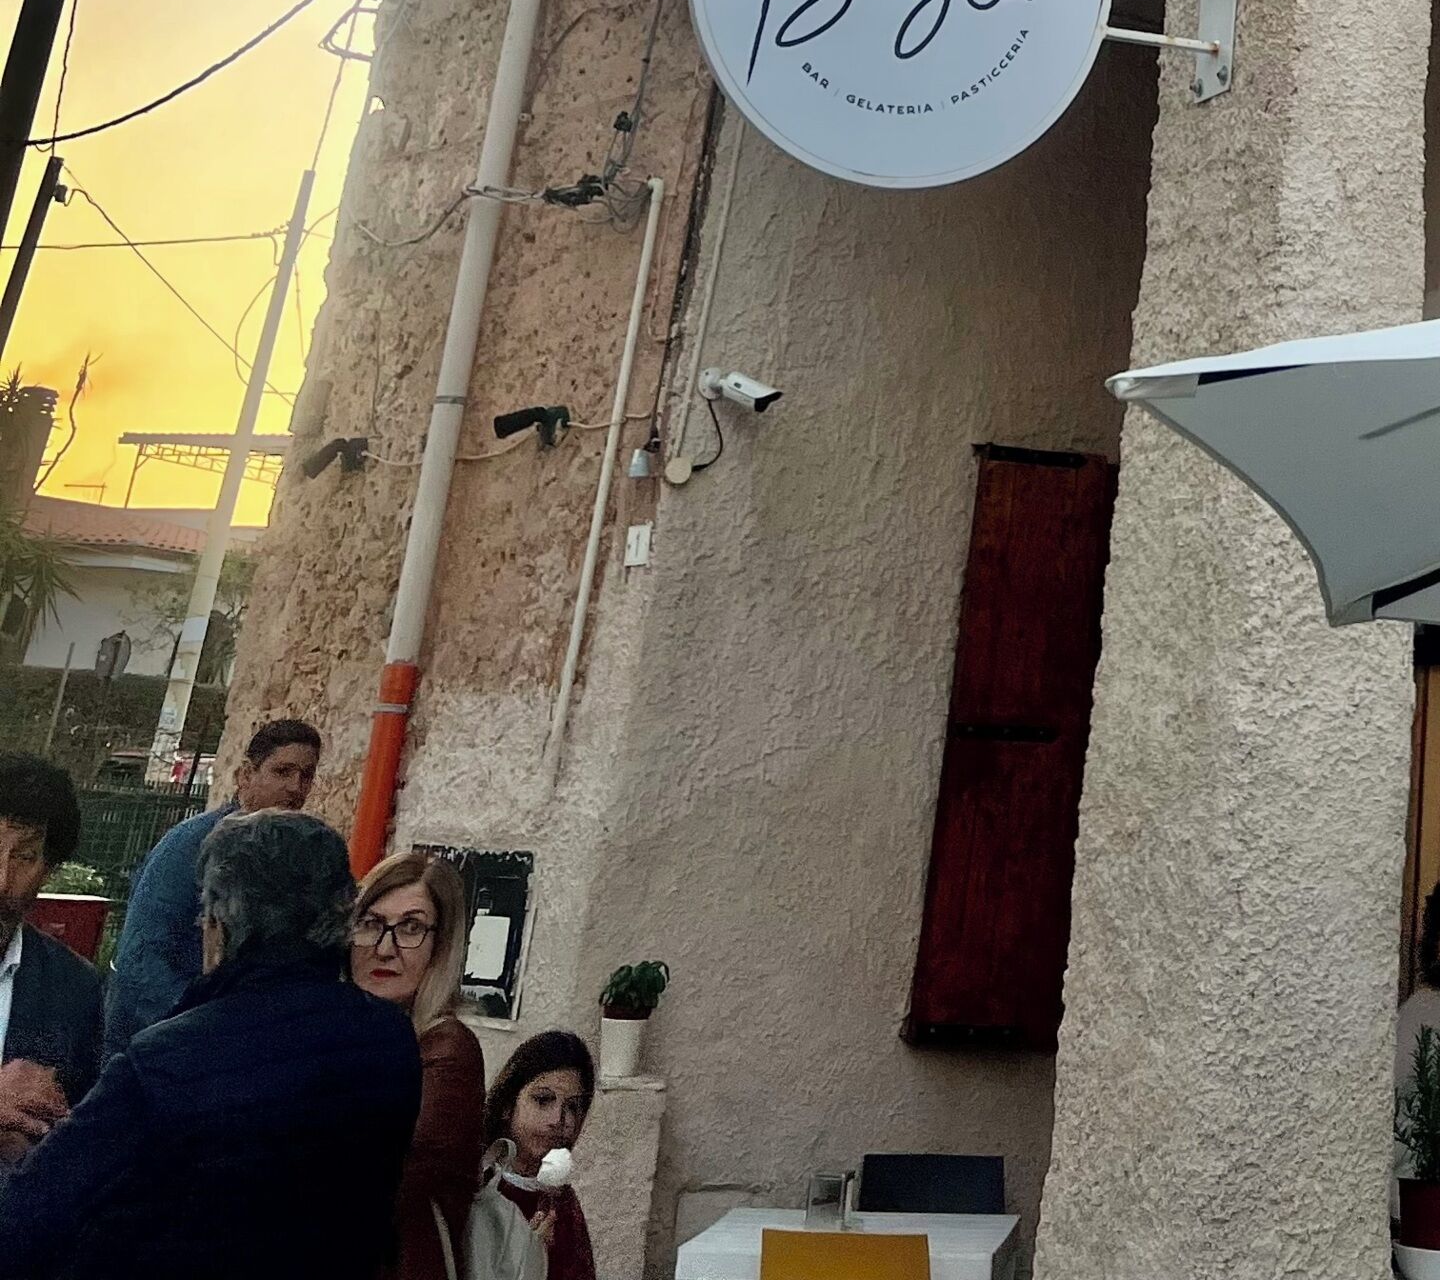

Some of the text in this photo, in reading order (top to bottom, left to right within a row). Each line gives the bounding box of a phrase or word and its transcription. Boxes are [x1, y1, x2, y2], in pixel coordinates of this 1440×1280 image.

[801, 28, 1030, 115] BAR GELATERIA PASTICCERIA
